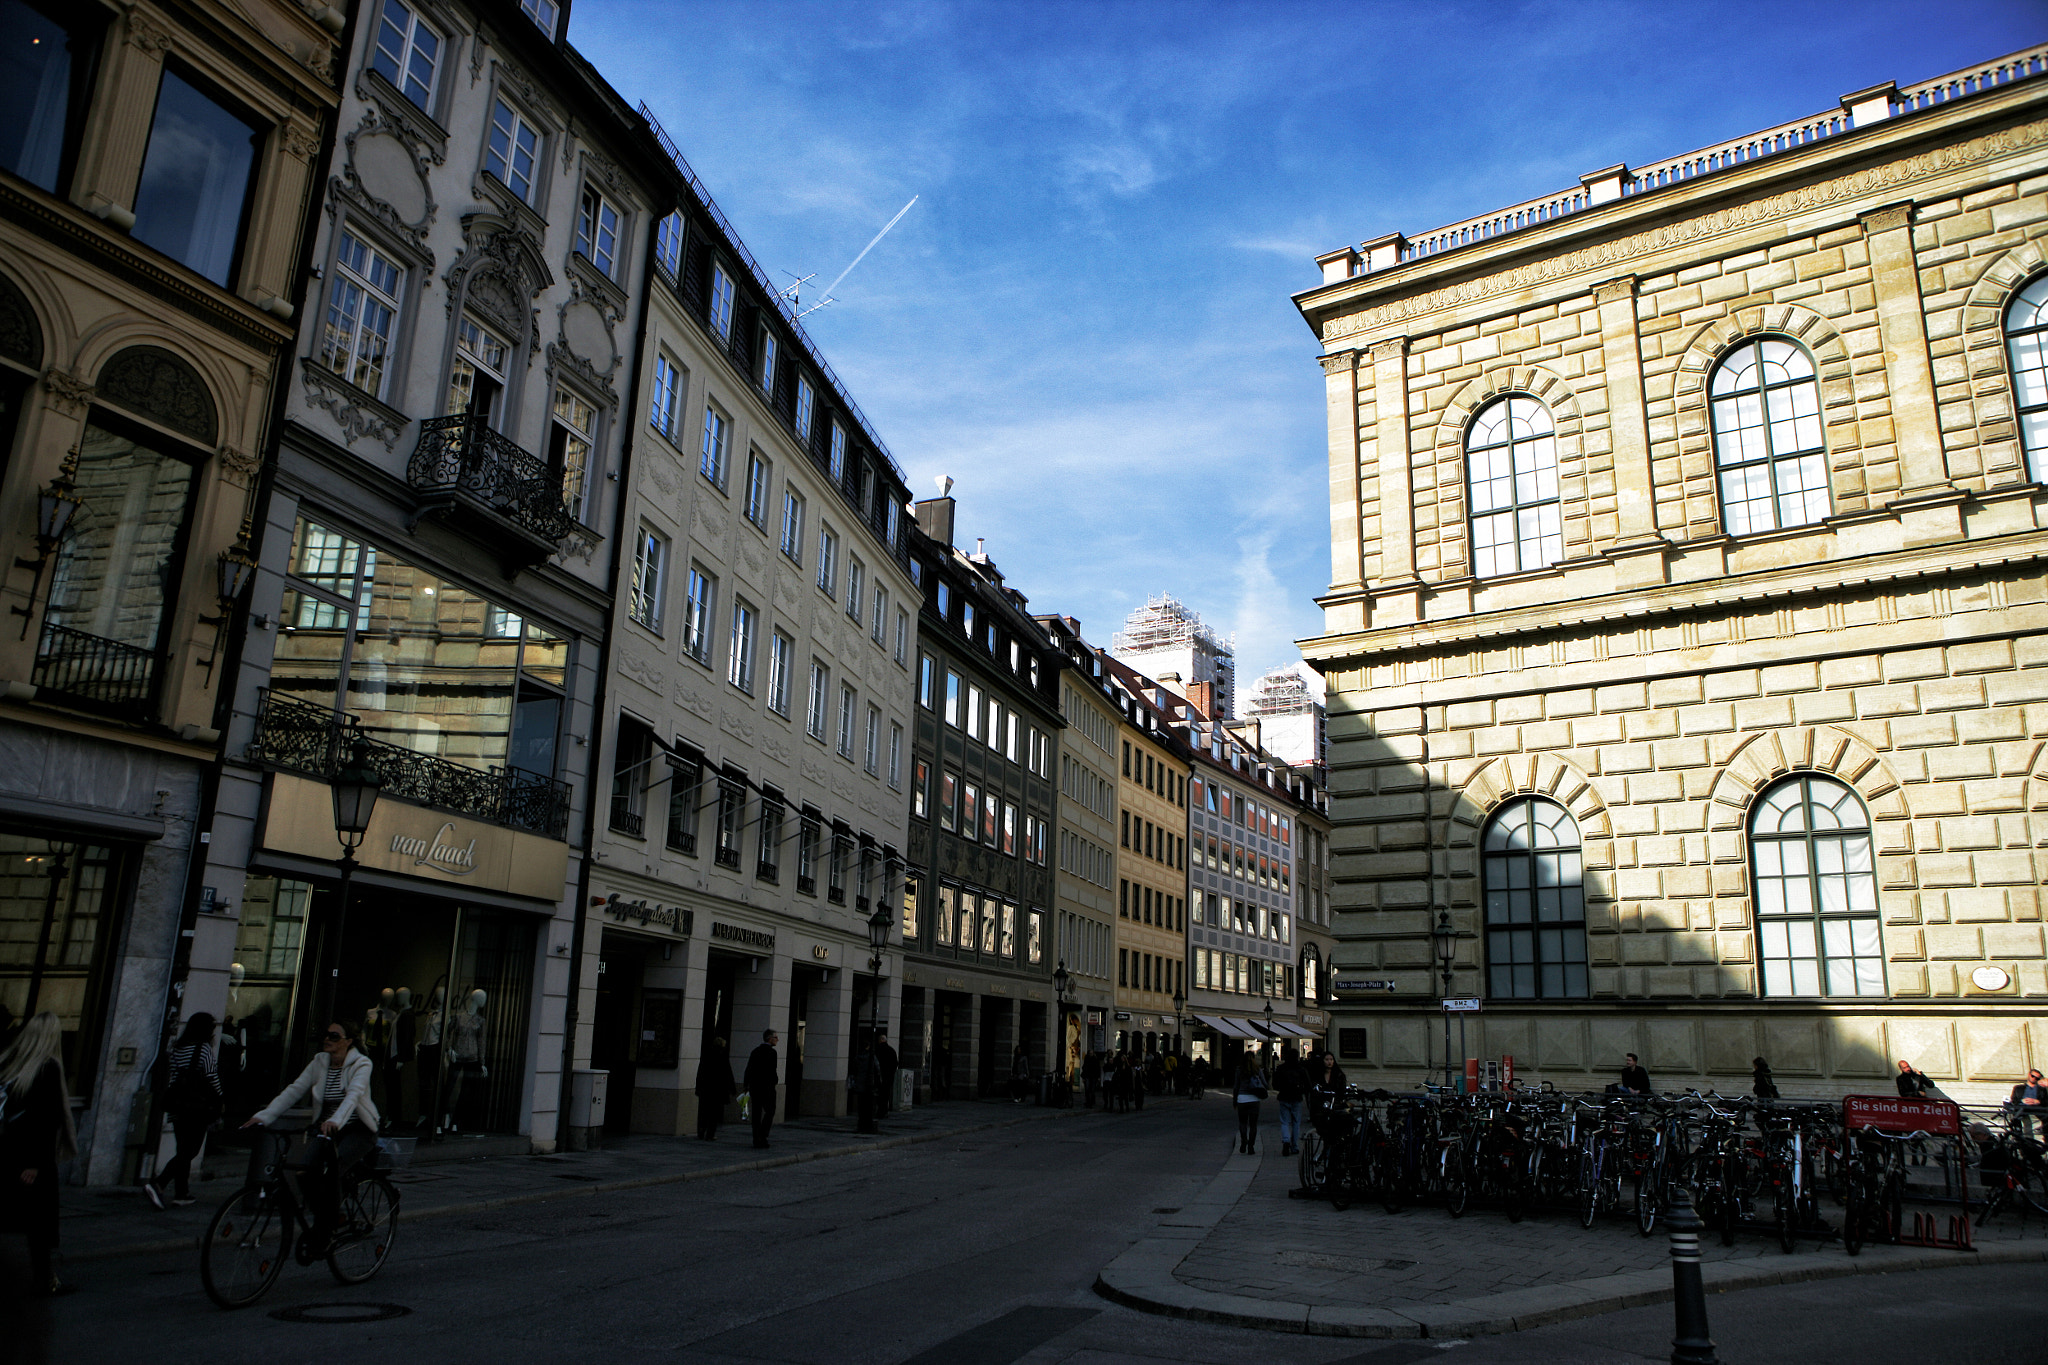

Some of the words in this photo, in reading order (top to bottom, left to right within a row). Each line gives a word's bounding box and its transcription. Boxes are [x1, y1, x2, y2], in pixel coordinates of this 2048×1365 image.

[391, 834, 427, 858] van
[415, 822, 480, 876] Laack
[203, 888, 214, 901] 17
[1851, 1100, 1869, 1111] Sie
[1872, 1102, 1898, 1113] sind
[1923, 1105, 1952, 1116] Ziel!
